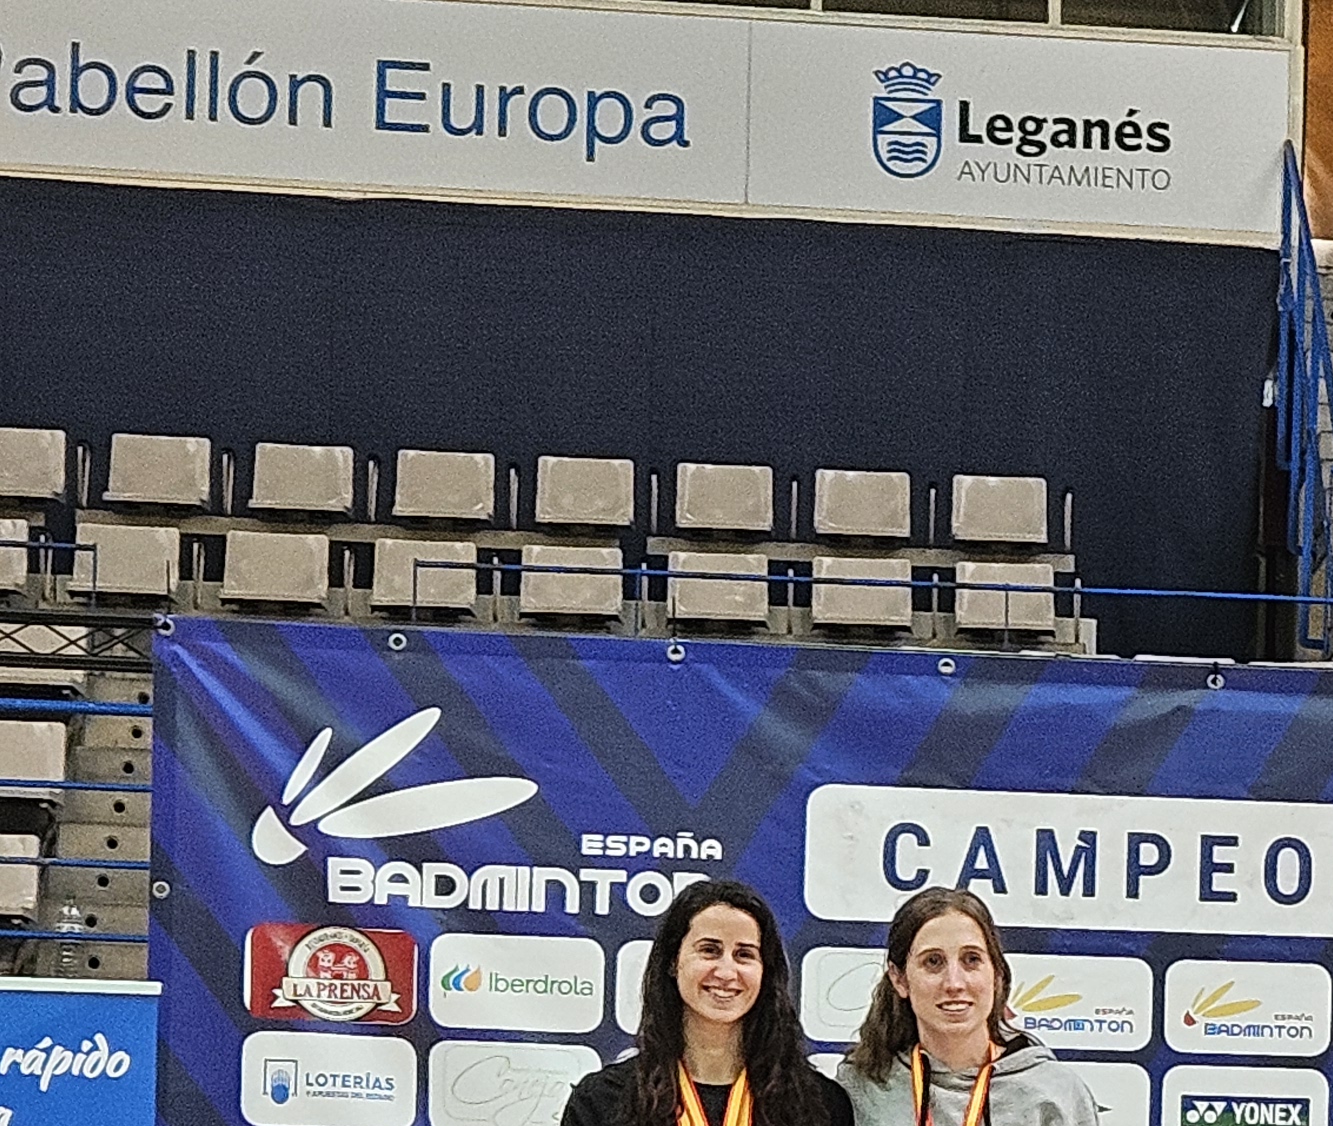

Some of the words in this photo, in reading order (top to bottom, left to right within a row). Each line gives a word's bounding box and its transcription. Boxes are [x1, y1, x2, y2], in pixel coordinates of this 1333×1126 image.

[6, 48, 335, 130] abellón
[374, 60, 692, 162] Europa
[957, 98, 1172, 160] Leganés
[957, 160, 1173, 193] AYUNTAMIENTO
[580, 830, 724, 861] ESPAÑA
[292, 983, 314, 998] LA
[316, 981, 382, 1001] PRENSA
[488, 969, 595, 997] Iberdrola
[1023, 1015, 1135, 1034] BADMINTON
[1203, 1021, 1314, 1040] BADMINTON
[1, 1032, 131, 1092] rápido
[305, 1071, 395, 1091] LOTERÍAS
[1232, 1102, 1302, 1126] YONEX
